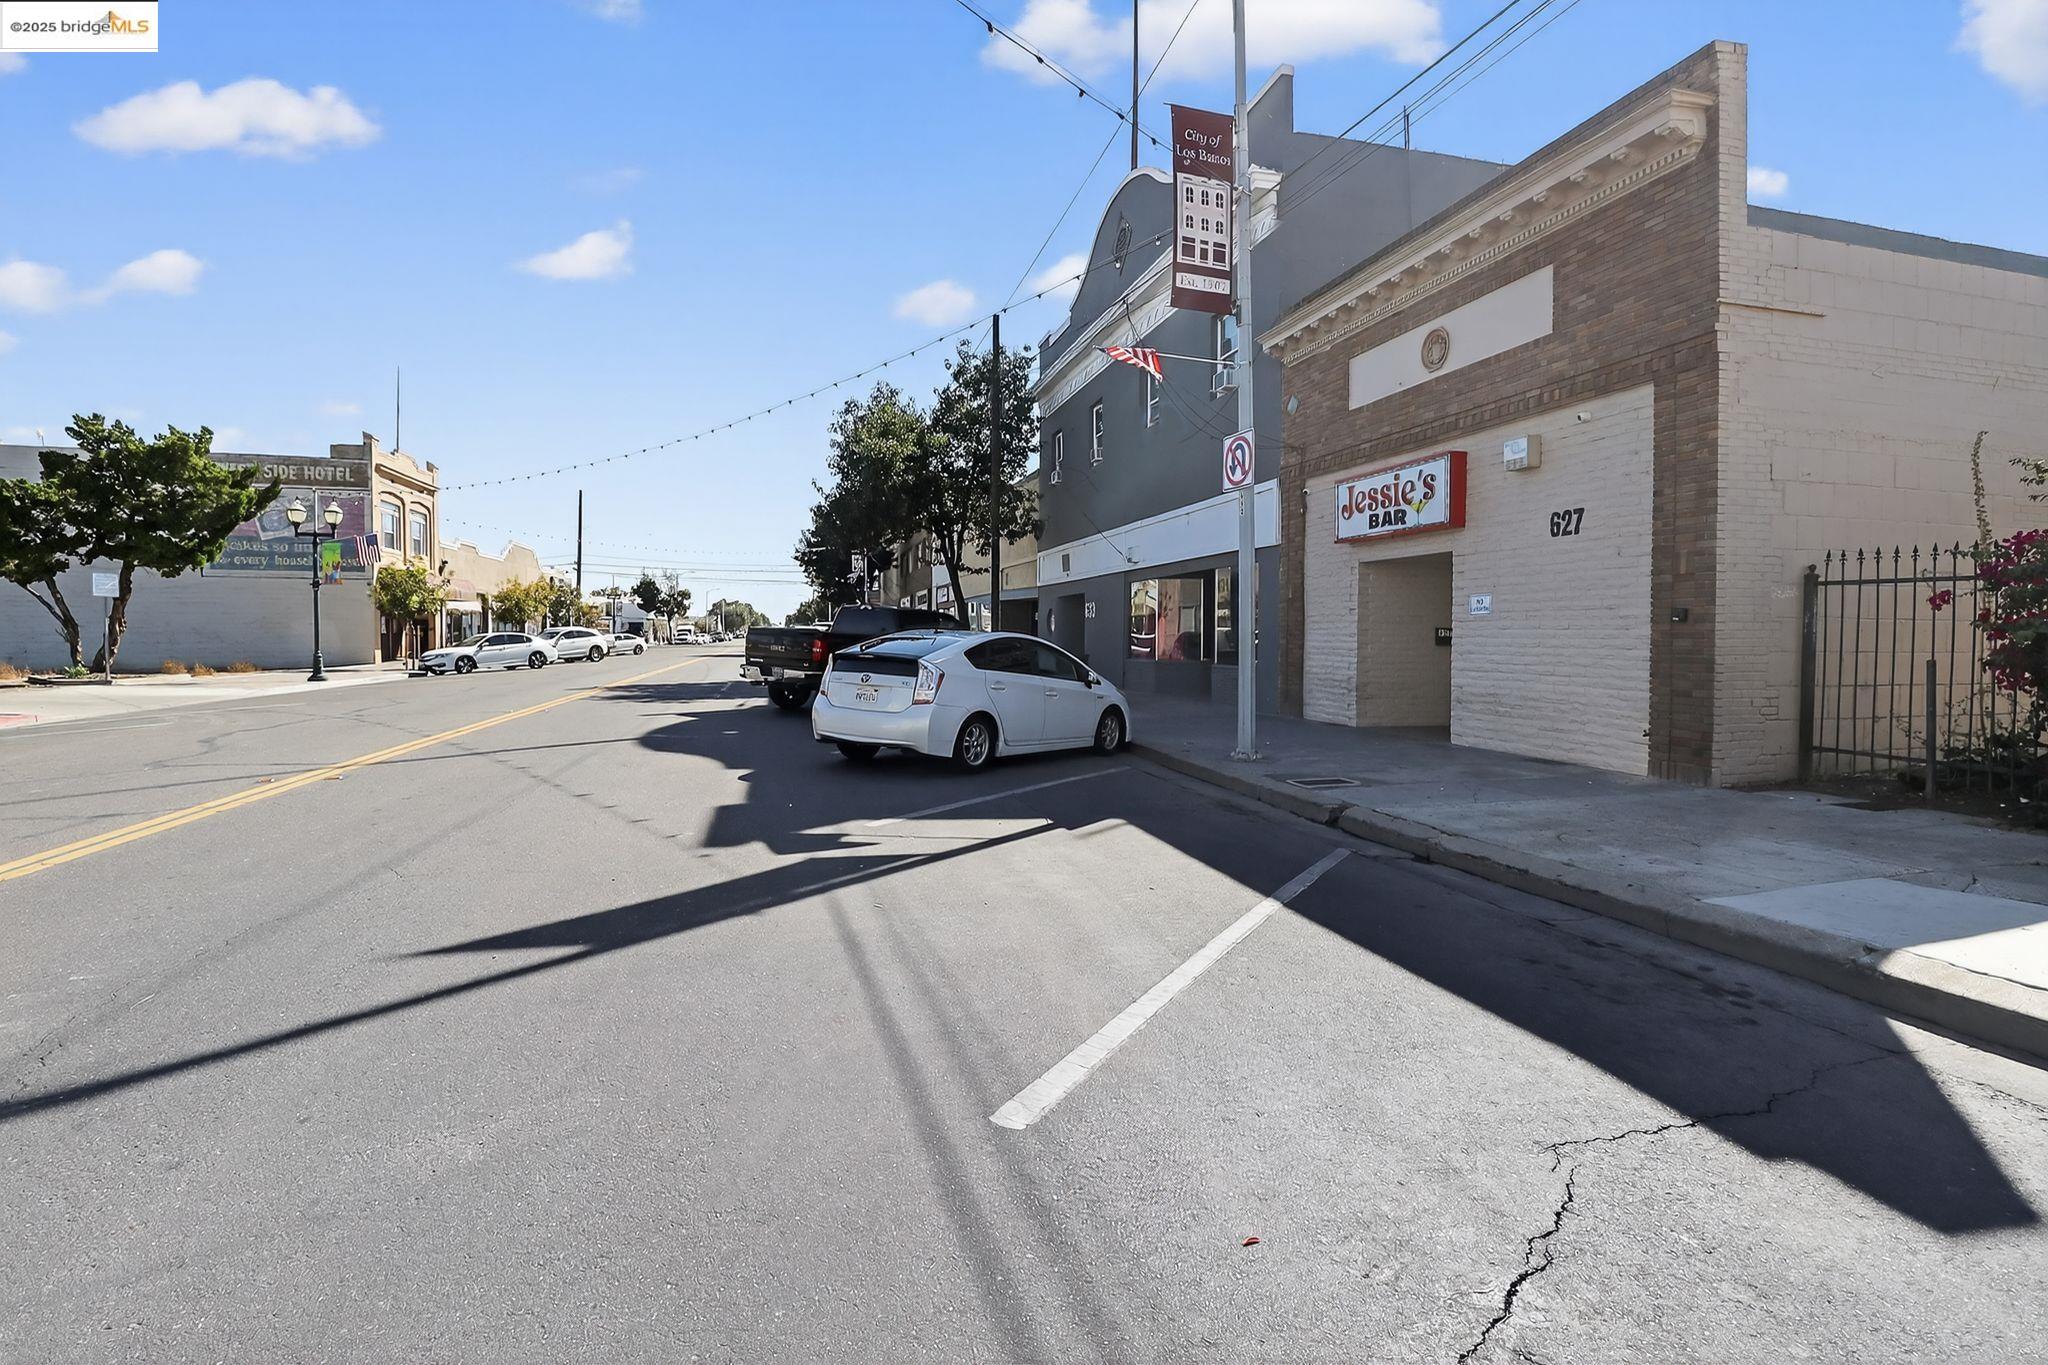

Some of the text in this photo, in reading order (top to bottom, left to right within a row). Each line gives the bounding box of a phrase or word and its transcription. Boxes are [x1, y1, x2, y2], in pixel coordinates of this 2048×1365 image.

[1185, 129, 1222, 148] City of
[1176, 144, 1196, 159] Los
[263, 464, 298, 481] SIDE
[303, 465, 355, 482] HOTEL
[1341, 469, 1437, 520] Jessie's
[1369, 508, 1407, 530] BAR
[1550, 507, 1585, 537] 627
